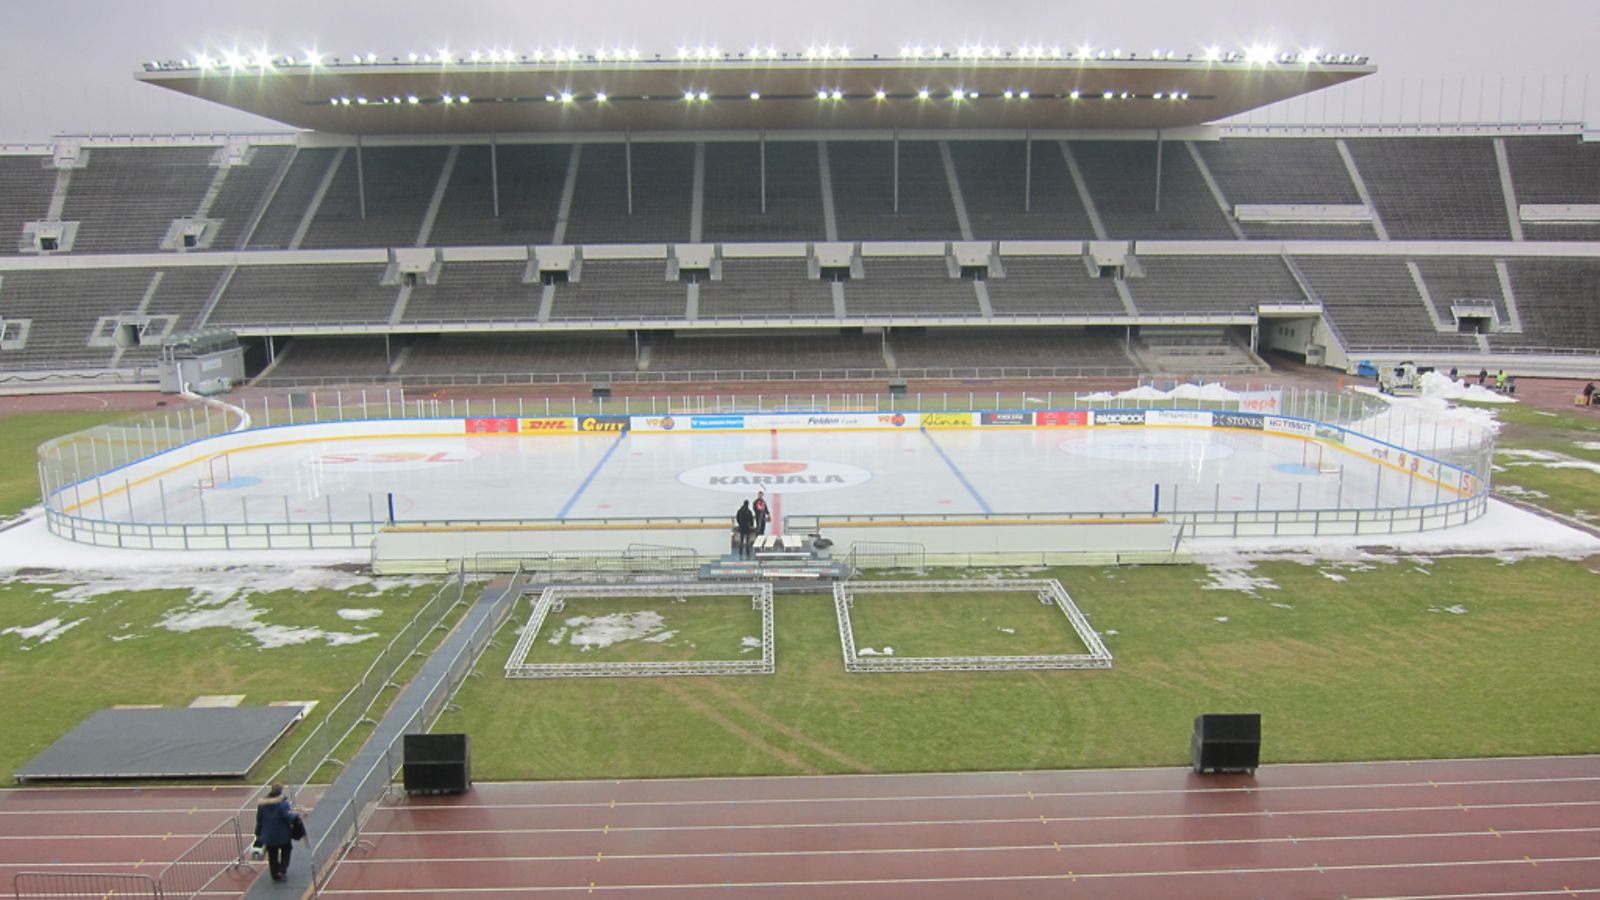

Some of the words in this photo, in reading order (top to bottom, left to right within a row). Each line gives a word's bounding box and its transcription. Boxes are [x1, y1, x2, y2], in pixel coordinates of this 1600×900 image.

[529, 421, 568, 429] DHL
[1226, 416, 1263, 428] STONES
[1284, 420, 1313, 432] TISSOT
[709, 475, 845, 485] KARJALA
